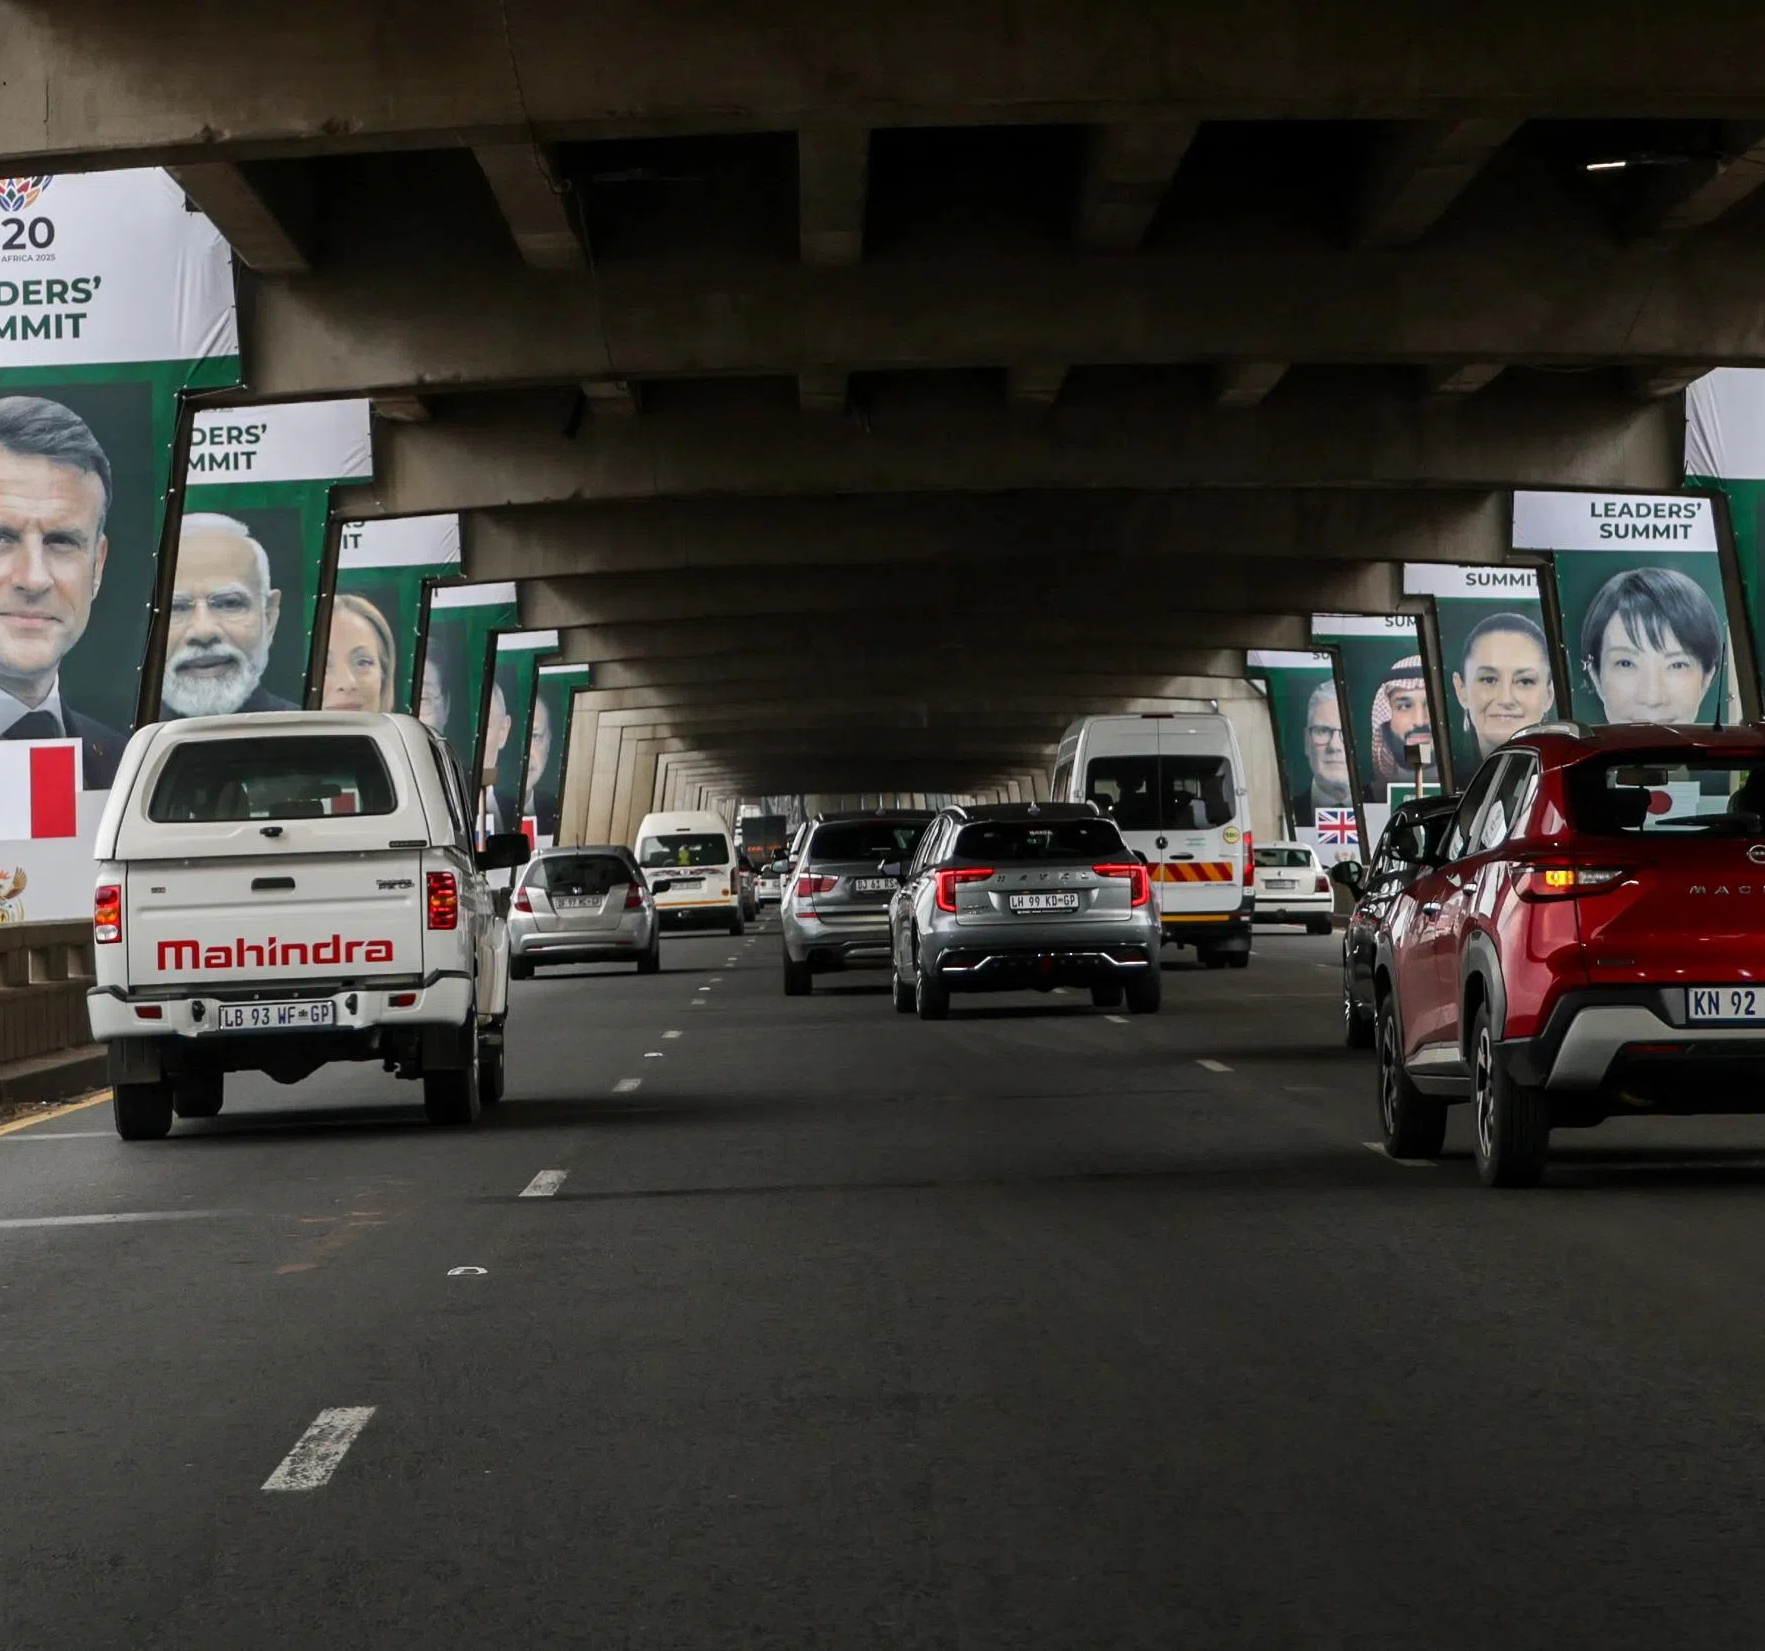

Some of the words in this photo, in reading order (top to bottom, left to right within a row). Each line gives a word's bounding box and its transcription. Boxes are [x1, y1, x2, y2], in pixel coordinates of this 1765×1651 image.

[1, 255, 34, 263] AFRICA
[36, 254, 56, 262] 2025
[1590, 502, 1702, 519] LEADERS’
[1599, 523, 1693, 540] SUMMIT
[1011, 896, 1025, 908] LH
[1028, 895, 1041, 908] 99
[1045, 894, 1058, 907] KD
[1063, 894, 1076, 906] GP
[157, 934, 394, 971] Mahindra
[1693, 990, 1720, 1016] KN
[1730, 990, 1756, 1016] 92
[224, 1007, 244, 1028] LB
[251, 1006, 271, 1026] 93
[277, 1005, 296, 1025] WF
[310, 1004, 330, 1023] GP
